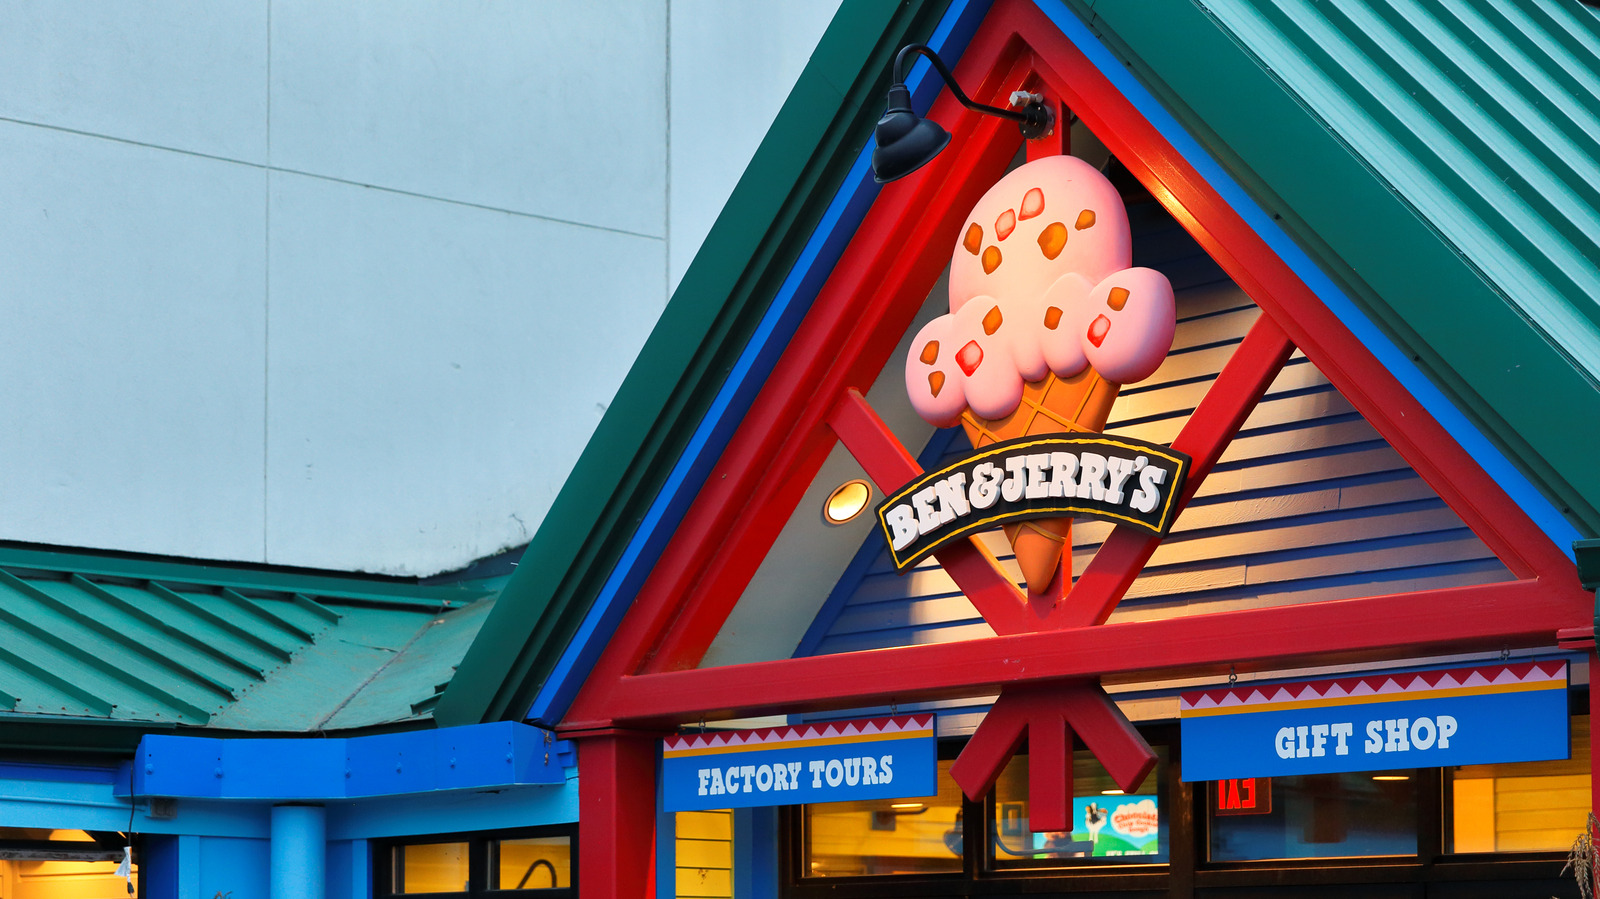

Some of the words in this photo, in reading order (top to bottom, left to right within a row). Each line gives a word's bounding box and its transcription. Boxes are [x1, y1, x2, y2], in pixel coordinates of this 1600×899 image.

[1275, 723, 1353, 759] GIFT
[1364, 715, 1458, 754] SHOP
[698, 761, 802, 796] FACTORY
[809, 755, 893, 788] TOURS
